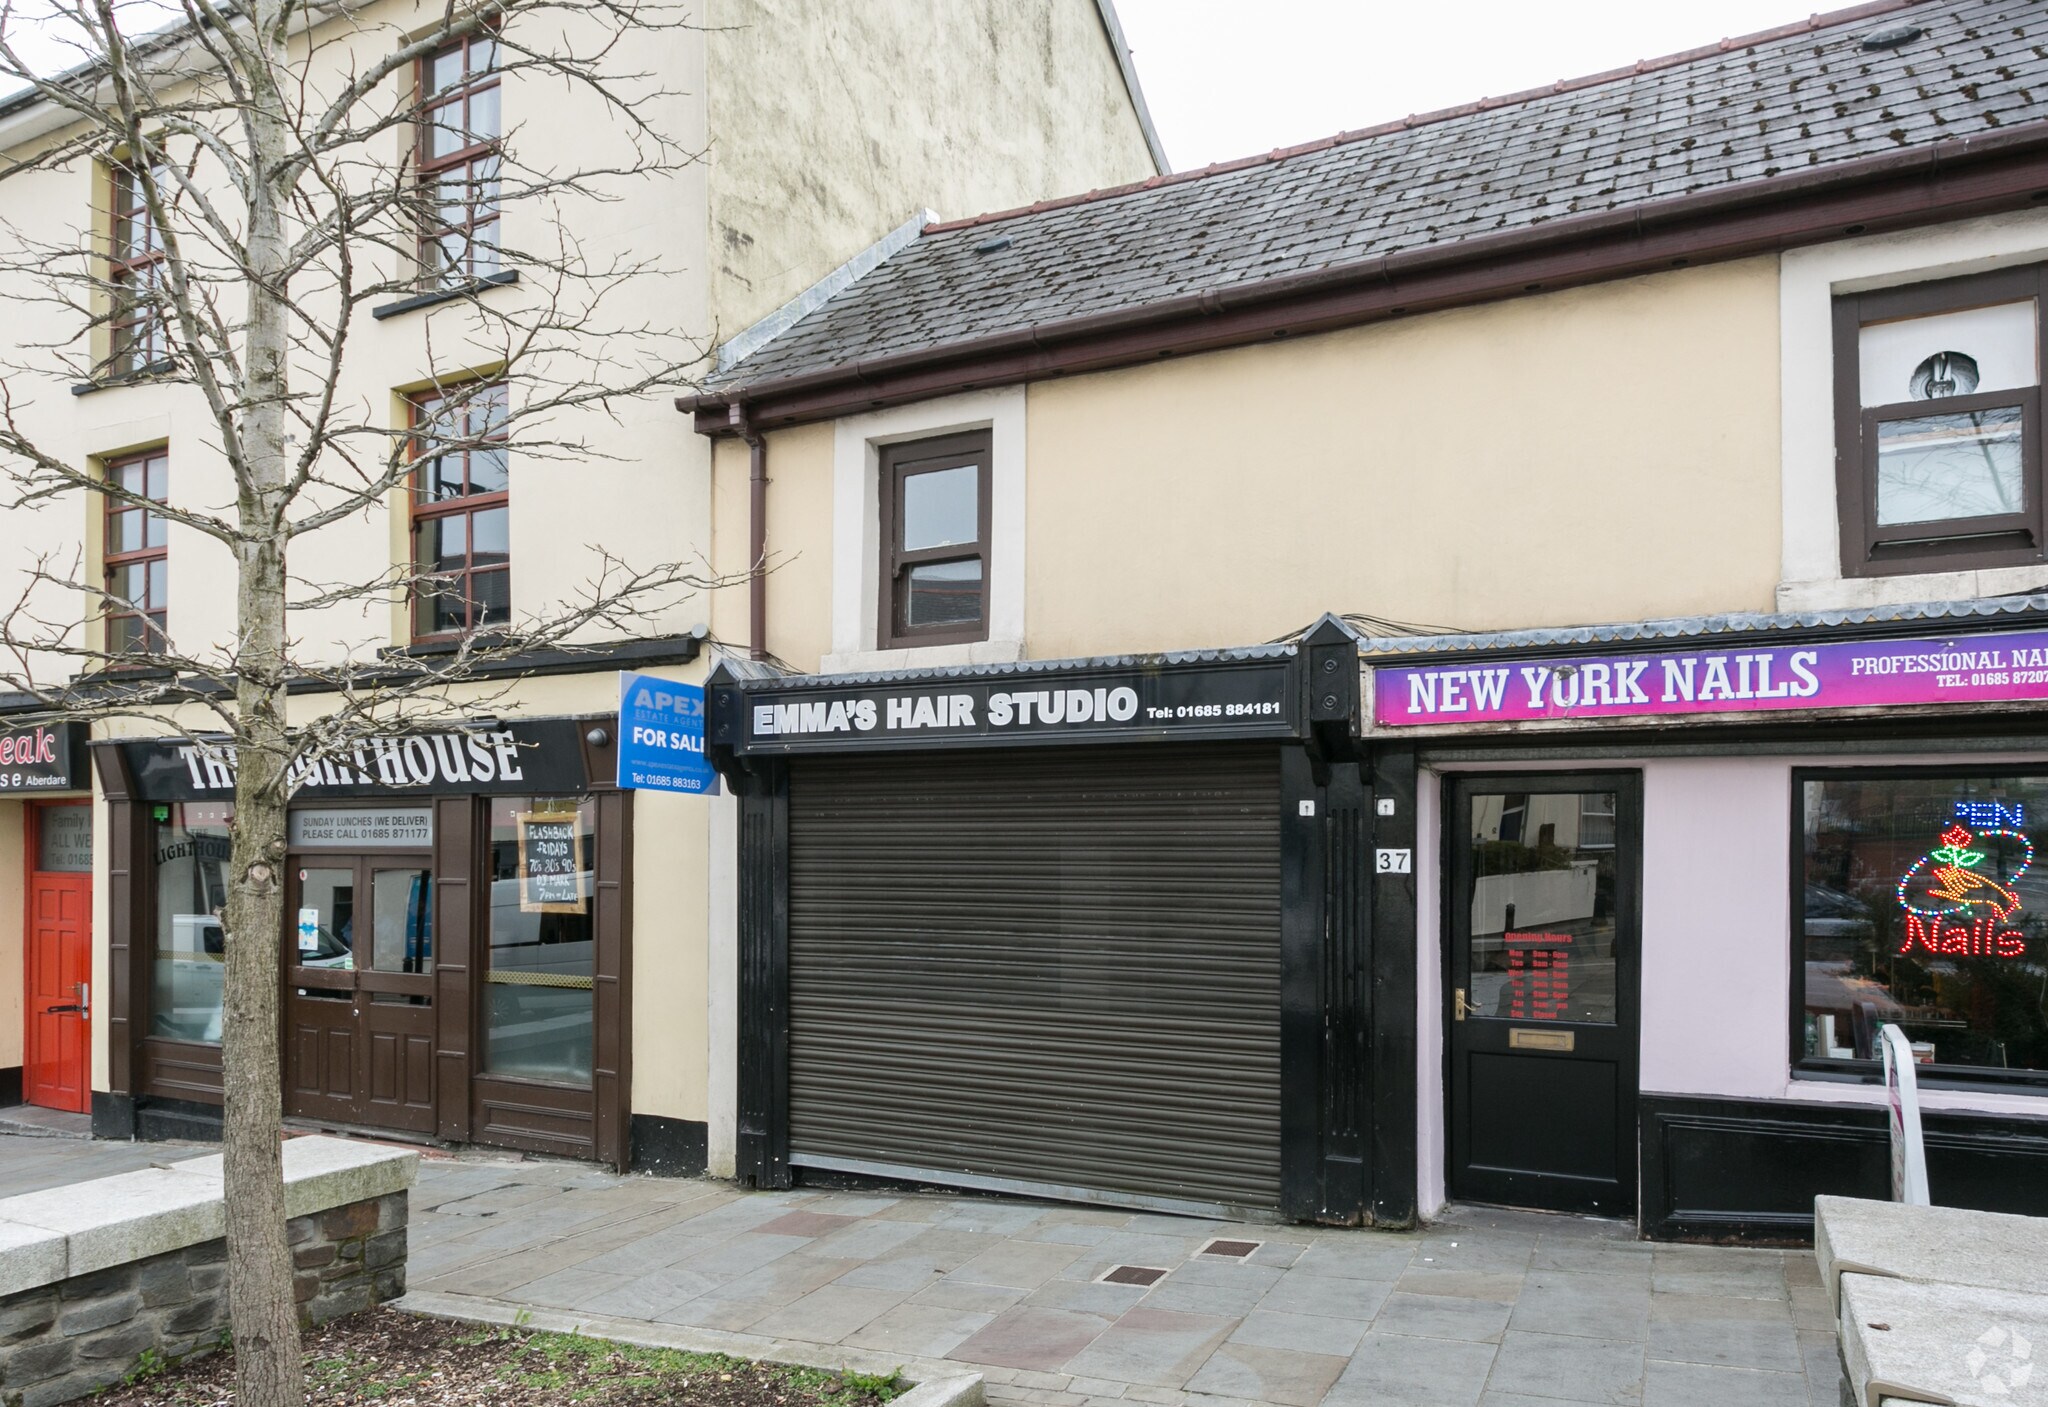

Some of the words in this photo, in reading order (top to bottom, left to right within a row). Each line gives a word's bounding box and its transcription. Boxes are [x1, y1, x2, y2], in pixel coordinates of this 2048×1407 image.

[1852, 651, 2007, 675] PROFESSIONAL
[1407, 668, 1510, 714] NEW
[1520, 661, 1649, 709] YORK
[1661, 651, 1820, 702] NAILS
[1936, 674, 1968, 687] TEL:
[1971, 672, 2009, 686] 01685
[634, 688, 704, 718] APEX
[753, 699, 878, 735] EMMA'S
[887, 694, 976, 729] HAIR
[988, 687, 1138, 726] STUDIO
[1147, 706, 1173, 719] Tel:
[1176, 705, 1222, 718] 01685
[1225, 702, 1281, 716] 884181
[635, 709, 668, 723] ESTATE
[0, 726, 56, 765] eak
[633, 726, 667, 748] FOR
[287, 730, 523, 787] GHTHOUSE
[25, 775, 67, 787] Aberdare
[632, 772, 645, 784] Tel:
[646, 774, 671, 787] 01685
[672, 777, 701, 790] 883163
[52, 812, 85, 830] Family
[303, 817, 335, 827] SUNDAY
[337, 816, 372, 827] LUNCHES
[374, 816, 390, 827] (WE
[392, 815, 428, 826] DELIVER)
[51, 833, 70, 848] ALL
[302, 829, 334, 839] PLEASE
[336, 829, 359, 839] CALL
[361, 828, 390, 838] 01685
[392, 828, 428, 838] 871177
[528, 825, 574, 840] FLASHBACK
[153, 841, 226, 866] LIGHTHOU
[536, 841, 568, 857] FRIDAYS
[1380, 852, 1408, 870] 37
[549, 875, 570, 887] MARK
[561, 888, 578, 901] LATE
[1504, 932, 1543, 943] Opening
[1544, 931, 1573, 943] Hours
[1900, 913, 2025, 956] Nails
